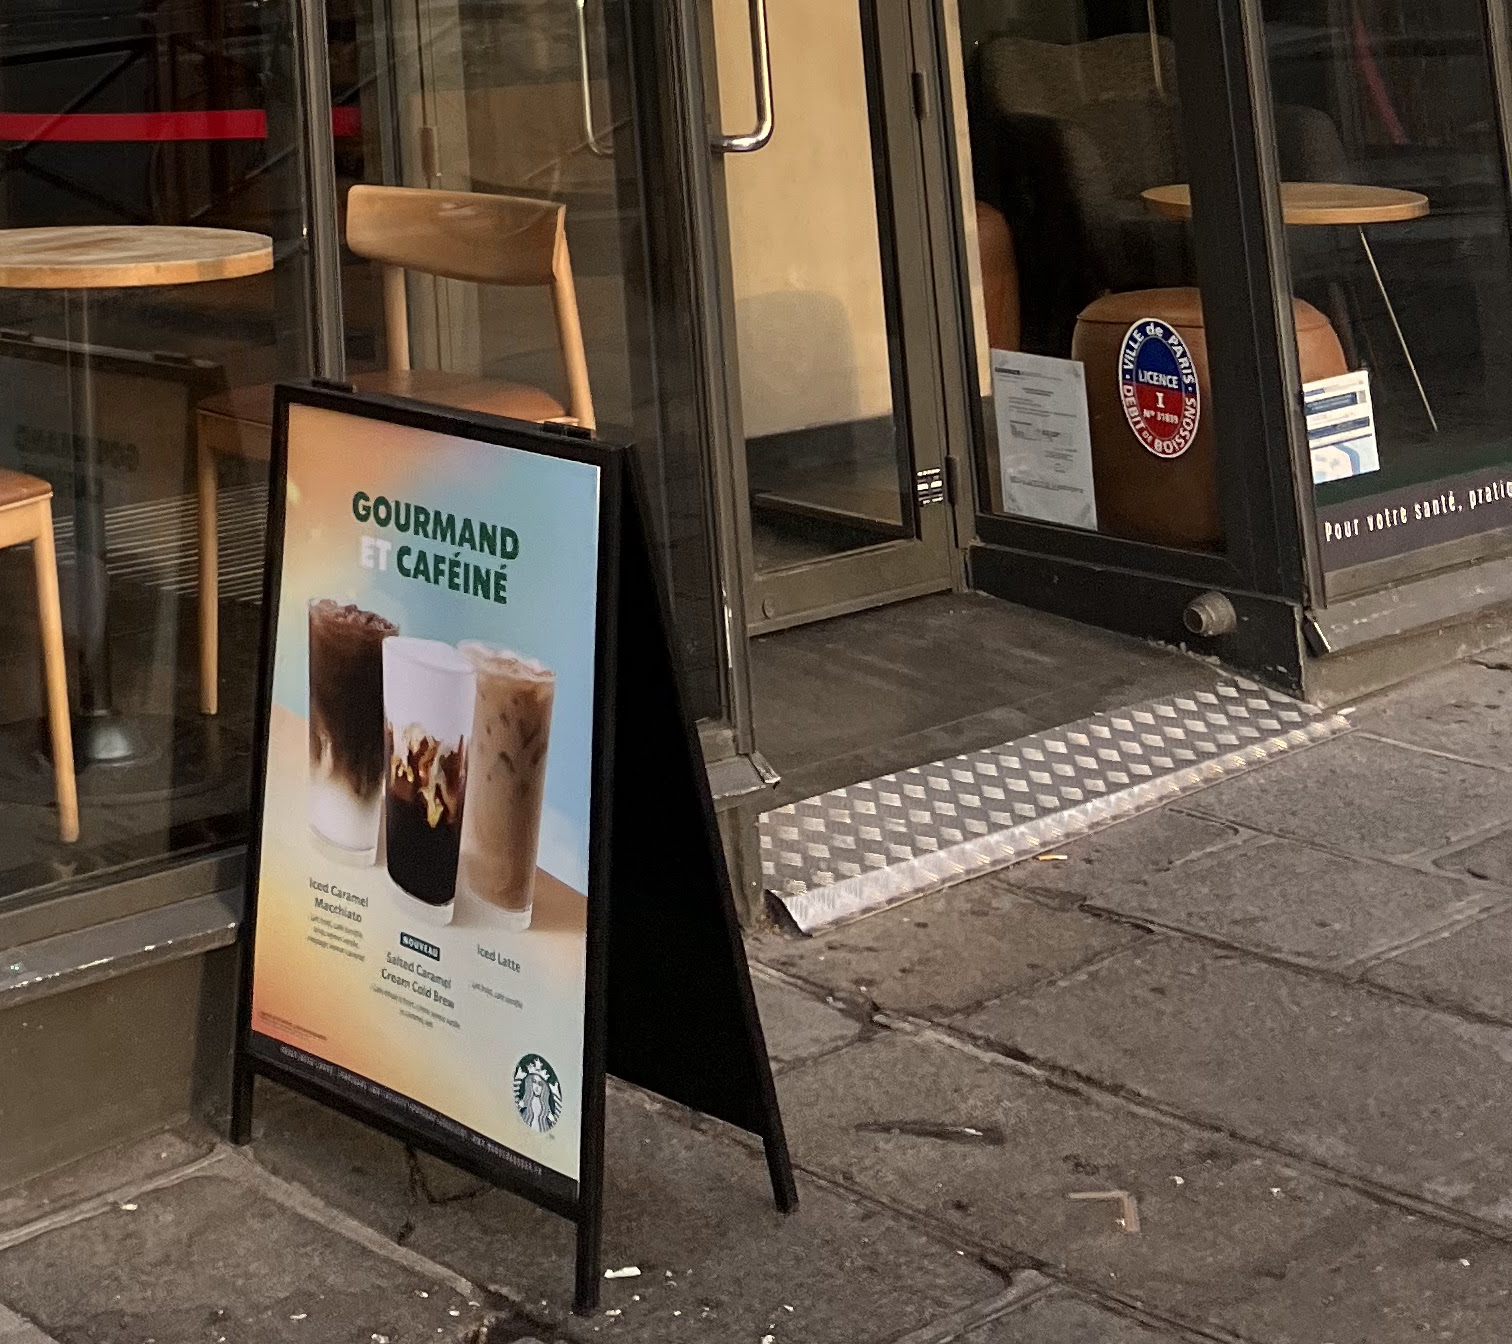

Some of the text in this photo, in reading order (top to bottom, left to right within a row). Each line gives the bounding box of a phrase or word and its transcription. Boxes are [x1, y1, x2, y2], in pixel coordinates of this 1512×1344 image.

[1123, 322, 1195, 384] VILLE de PARIS
[1138, 369, 1179, 389] LICENCE
[1123, 384, 1145, 431] DEBIT
[1154, 397, 1196, 454] BOISSONS
[352, 490, 520, 561] GOURMAND
[1324, 518, 1359, 542] Pour
[1366, 506, 1407, 531] votre
[1414, 490, 1463, 520] santé,
[359, 536, 509, 605] ET CAFÉINÉ
[309, 877, 369, 908] Iced Caramel
[314, 897, 362, 923] Macchiato
[401, 934, 439, 958] NOUVEAU
[477, 943, 521, 973] Iced Latte
[381, 968, 410, 988] Cream
[412, 981, 432, 999] Cold
[433, 989, 455, 1009] Brew
[386, 951, 452, 990] Salted Caramel
